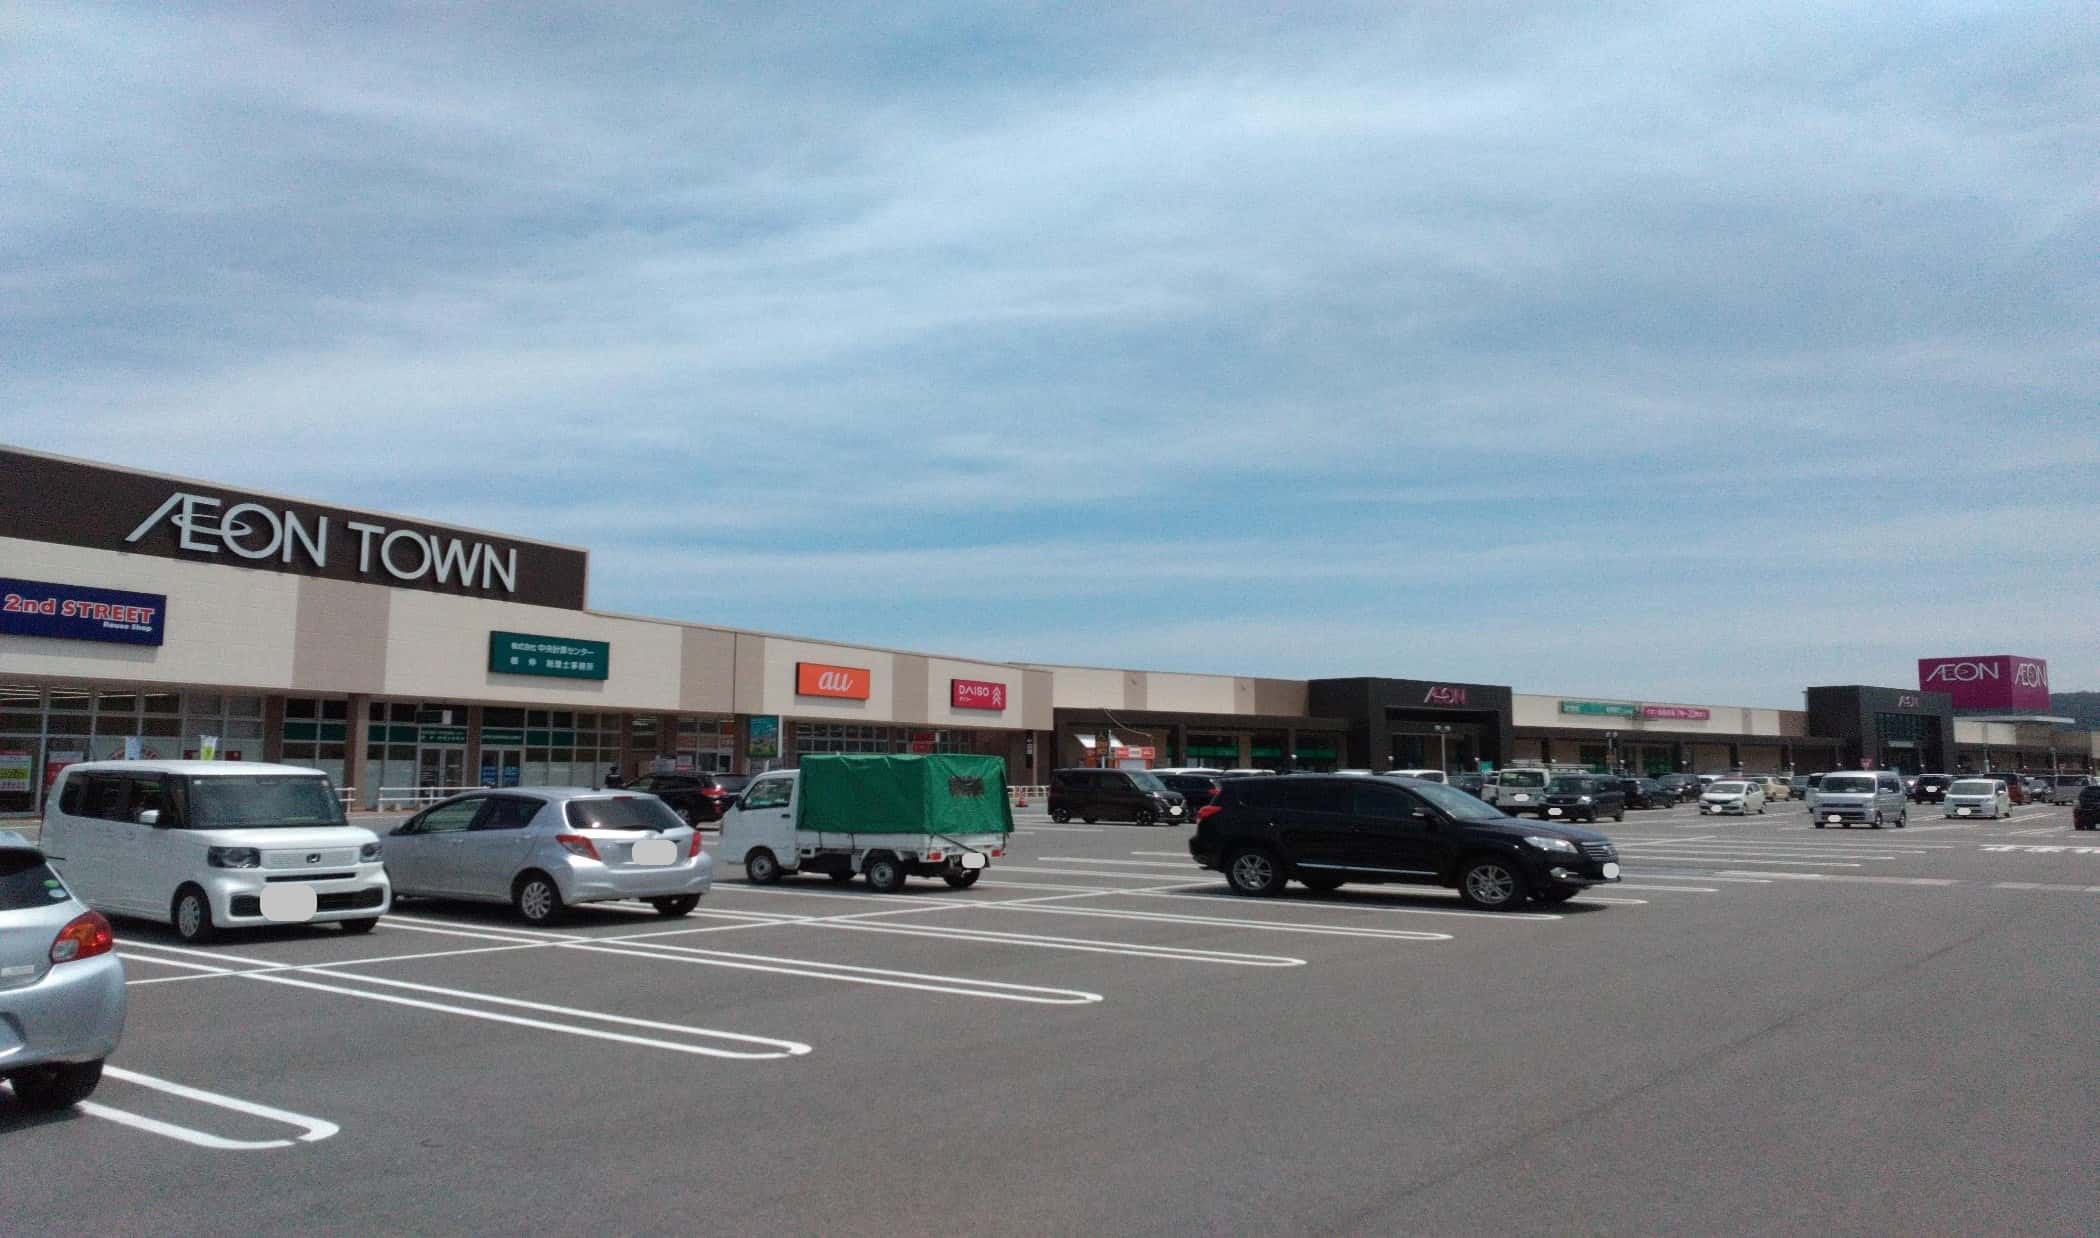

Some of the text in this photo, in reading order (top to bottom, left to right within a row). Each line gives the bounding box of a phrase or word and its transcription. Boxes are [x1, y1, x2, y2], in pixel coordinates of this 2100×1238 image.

[347, 520, 518, 593] TOWN
[3, 593, 156, 624] 2nd STREET
[818, 671, 853, 691] au
[959, 684, 990, 697] DAISO
